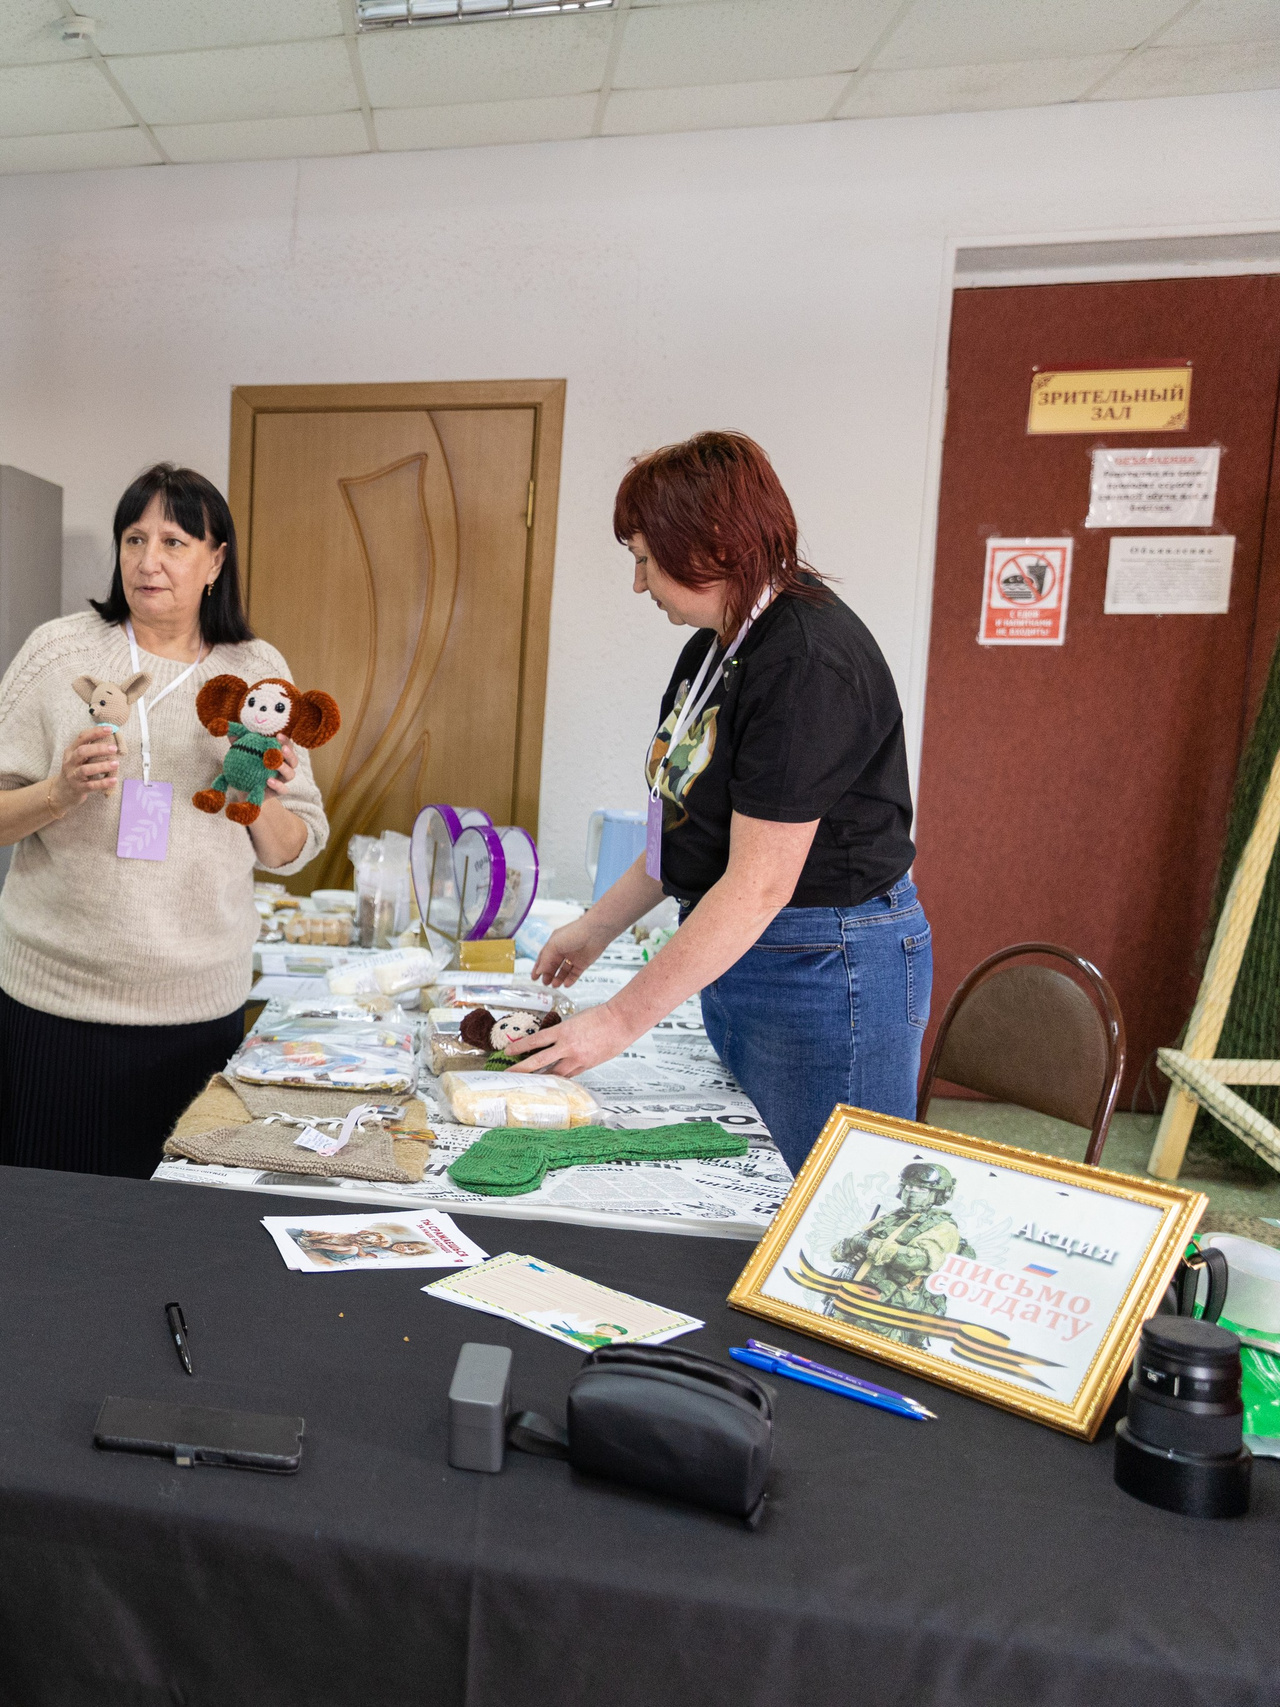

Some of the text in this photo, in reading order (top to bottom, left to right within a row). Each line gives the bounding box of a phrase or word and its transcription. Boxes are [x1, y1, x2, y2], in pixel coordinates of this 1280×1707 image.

[1038, 383, 1184, 406] ЗРИТЕЛЬНЫЙ
[1091, 407, 1132, 421] ЗАЛ
[1014, 1220, 1119, 1262] Акция
